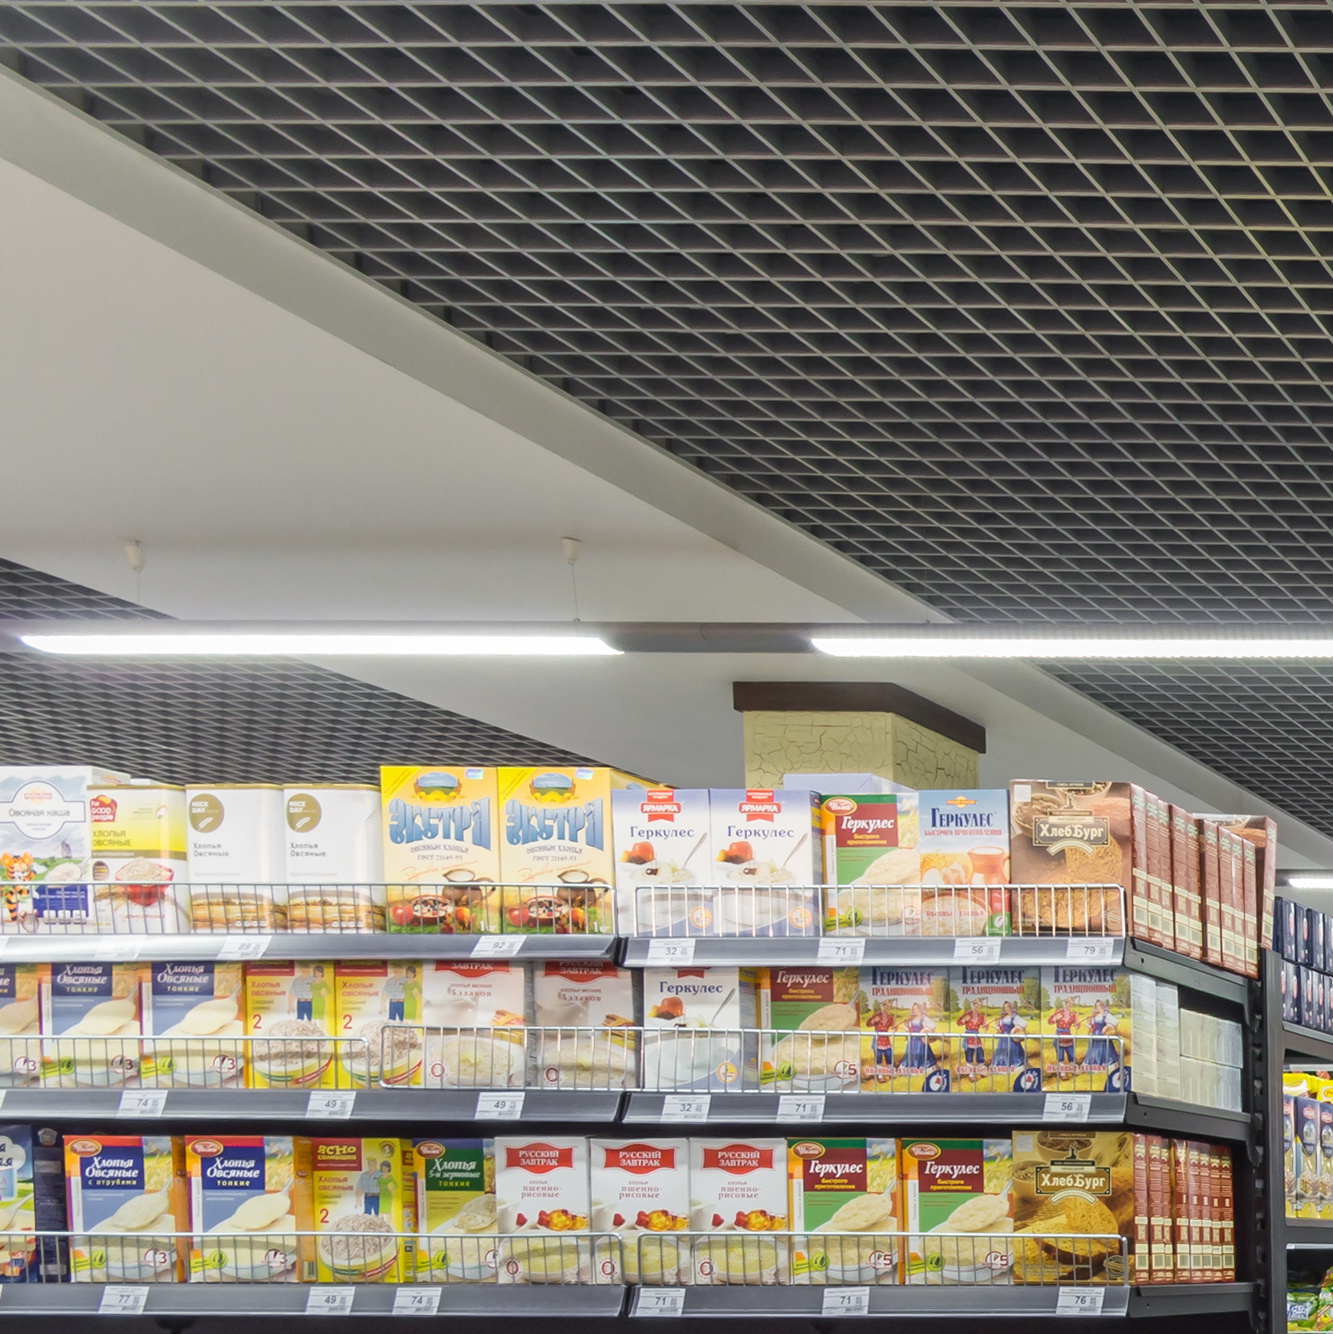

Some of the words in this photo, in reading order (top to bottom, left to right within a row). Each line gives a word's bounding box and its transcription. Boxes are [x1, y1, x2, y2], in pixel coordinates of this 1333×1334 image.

[931, 806, 994, 828] ГЕРКУЛЕС
[841, 816, 894, 831] Геркулес
[630, 826, 694, 840] Геркулес
[727, 826, 794, 840] Геркулес
[665, 946, 678, 955] 32
[835, 946, 846, 954] 71
[165, 964, 204, 976] Хлопья
[157, 974, 208, 985] Овсяные
[659, 982, 722, 995] Геркулес
[518, 1150, 558, 1160] РУССКИЙ
[215, 1158, 257, 1171] Хлопья
[520, 1158, 558, 1166] ЗАВТРАК
[206, 1168, 261, 1180] Овсяные
[809, 1161, 863, 1178] Геркулес
[1074, 1296, 1086, 1304] 76
